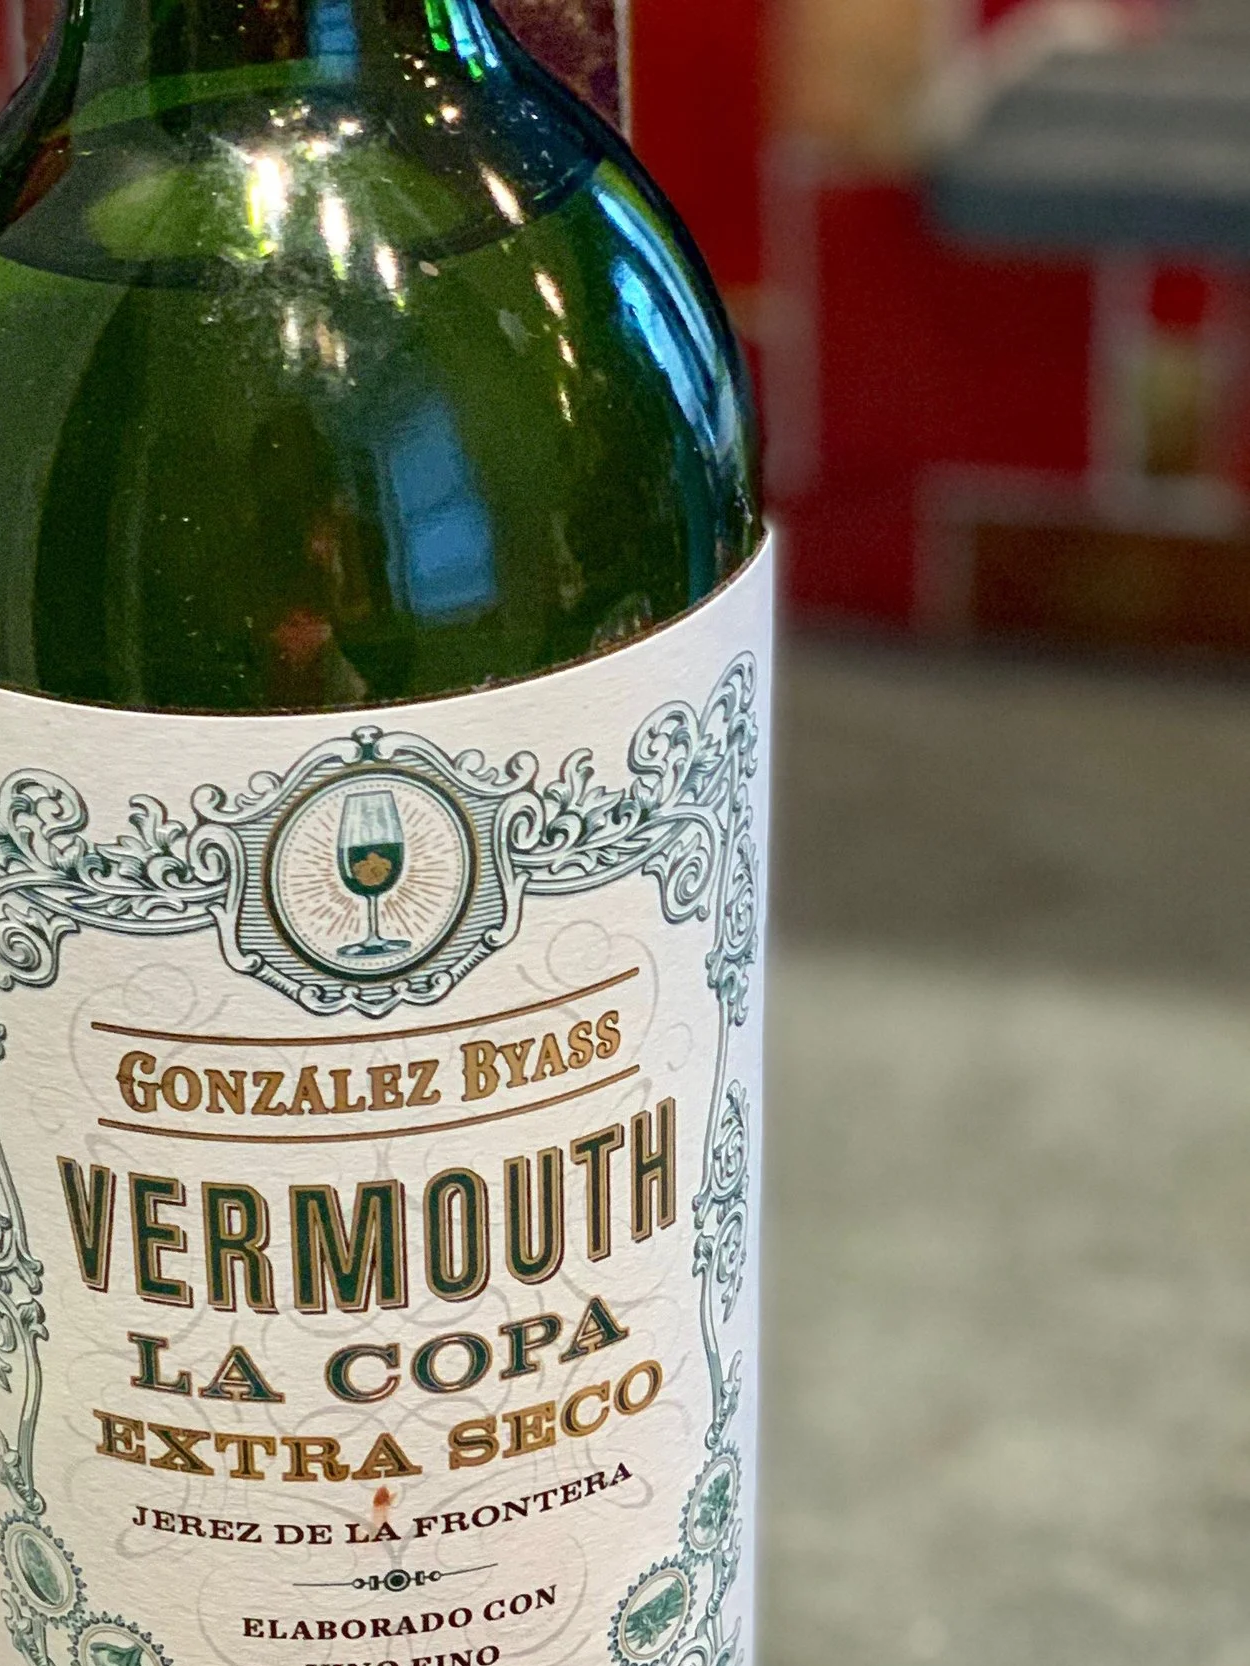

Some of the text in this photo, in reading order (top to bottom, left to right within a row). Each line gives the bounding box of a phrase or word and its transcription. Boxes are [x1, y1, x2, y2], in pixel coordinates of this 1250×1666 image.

[462, 1010, 621, 1102] BYASS
[56, 1096, 677, 1315] VERMOUTH
[127, 1295, 630, 1403] LA COPA
[92, 1359, 663, 1483] EXTRA SECO
[131, 1461, 634, 1545] JEREZ DE LA FRONTERA
[242, 1583, 558, 1640] ELABORADO CON
